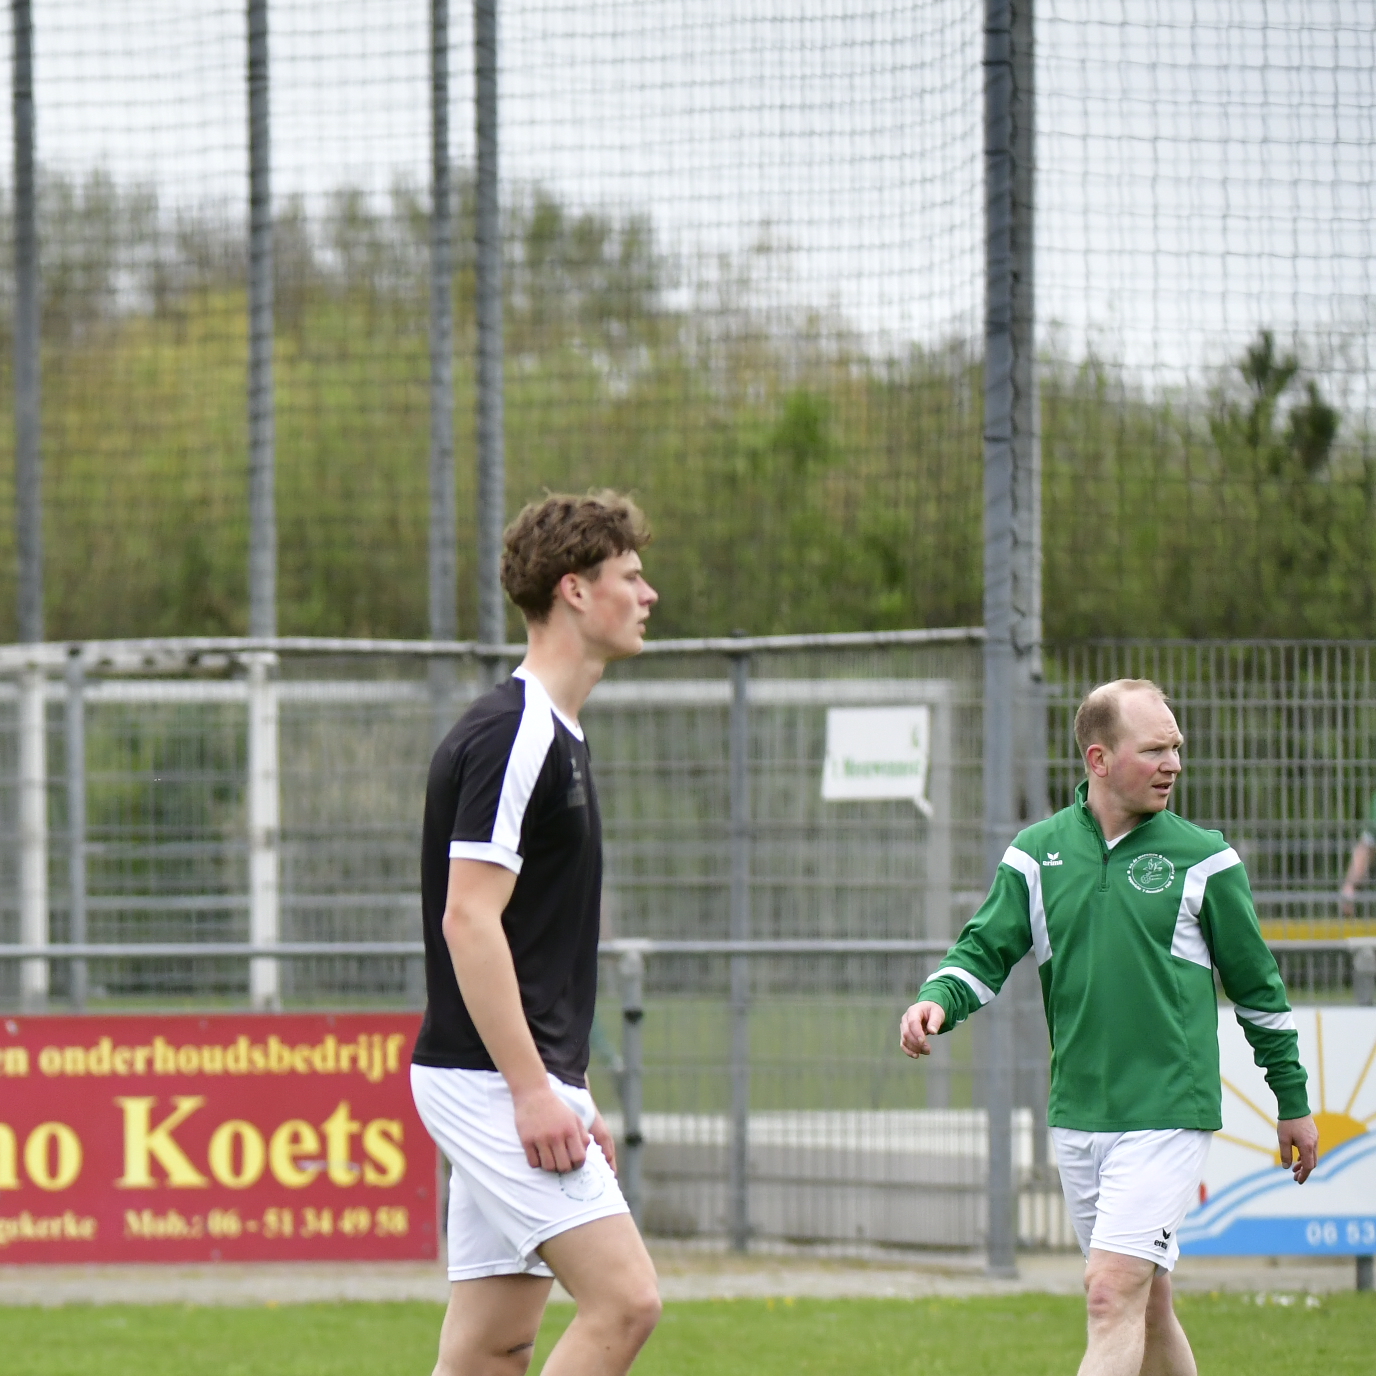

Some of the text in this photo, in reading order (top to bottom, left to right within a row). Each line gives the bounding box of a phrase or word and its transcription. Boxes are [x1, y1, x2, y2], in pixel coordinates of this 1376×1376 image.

[1042, 859, 1063, 867] erima
[37, 1033, 406, 1084] onderhoudsbedrijf
[113, 1094, 407, 1191] Koets
